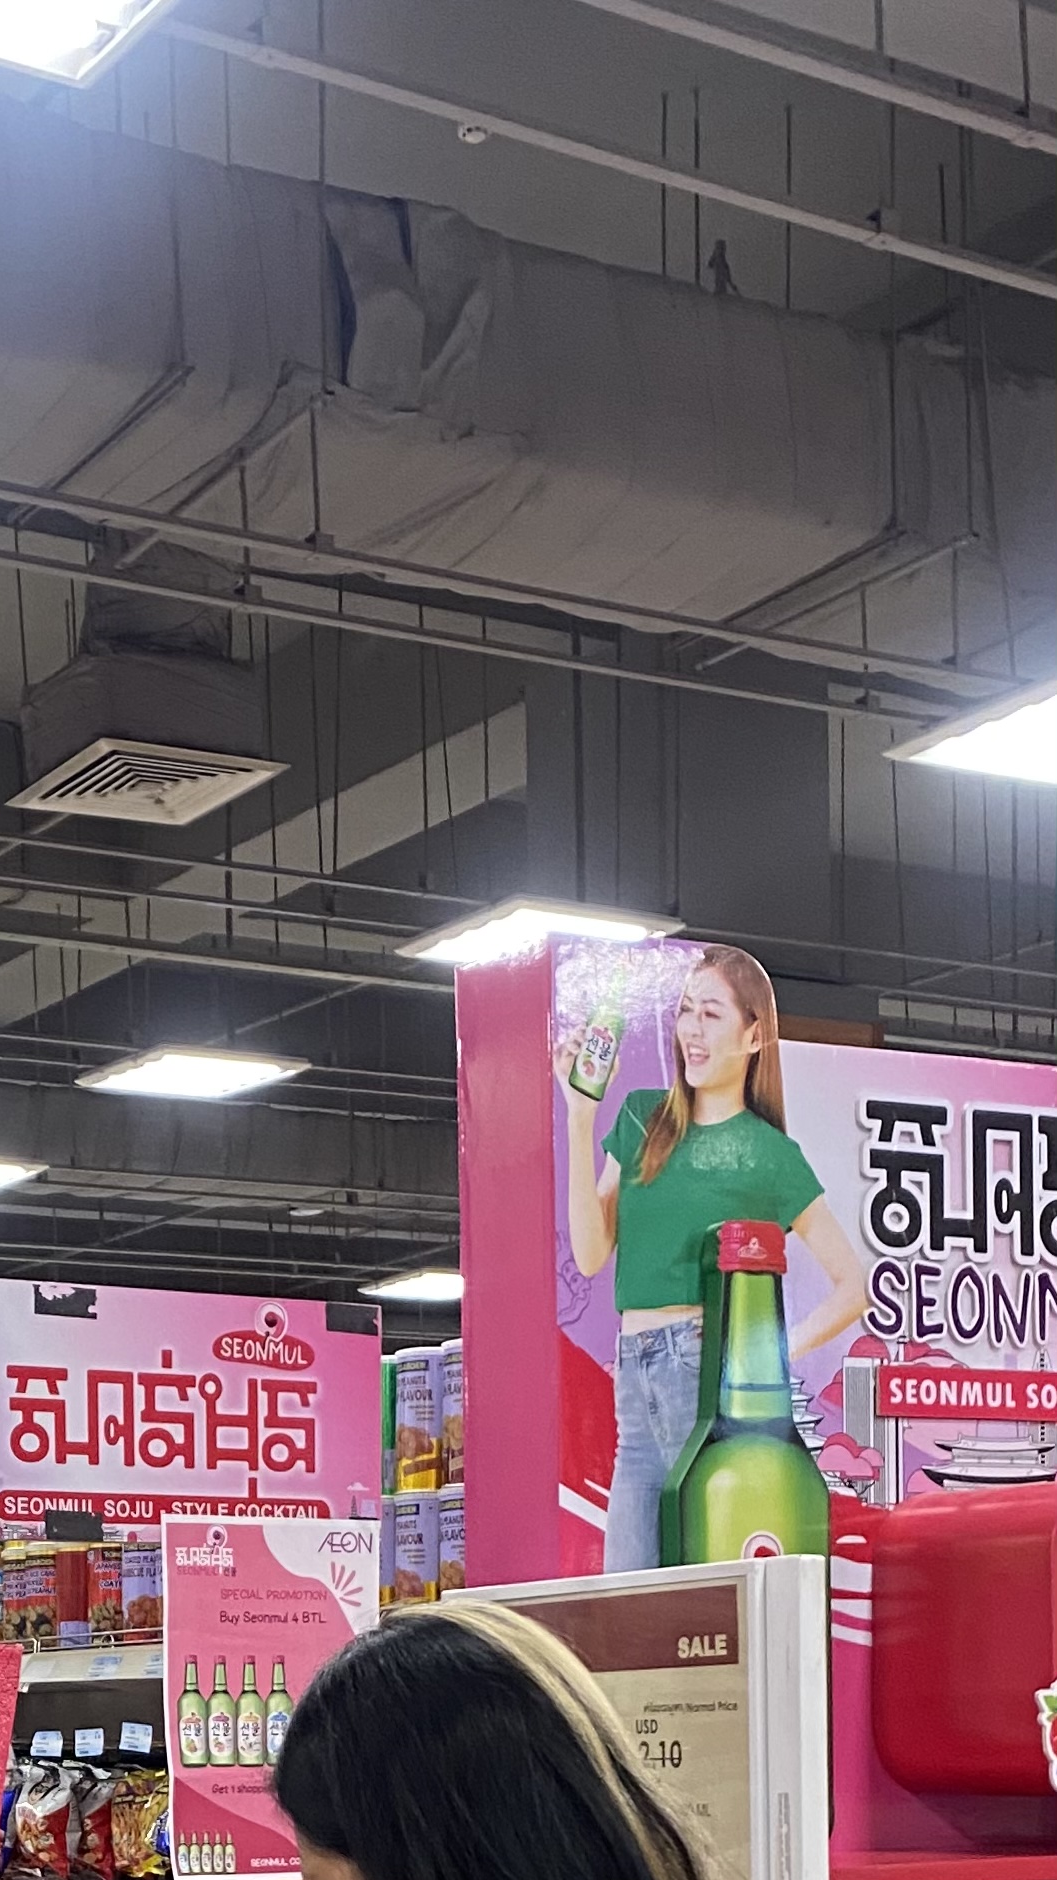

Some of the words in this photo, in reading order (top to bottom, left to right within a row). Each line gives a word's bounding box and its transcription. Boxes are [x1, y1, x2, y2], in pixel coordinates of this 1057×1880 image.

[219, 1337, 308, 1365] SEONMUL
[889, 1378, 1016, 1408] SEONMUL
[4, 1495, 94, 1517] SEONMUL
[104, 1499, 153, 1518] SOJU
[171, 1501, 228, 1517] STYLE
[234, 1503, 318, 1519] COCKTAIL
[220, 1588, 264, 1600] SPECIAL
[266, 1588, 328, 1601] PROMOTION
[219, 1610, 241, 1625] Buy
[243, 1610, 289, 1624] Seonmul
[292, 1612, 299, 1623] 4
[302, 1611, 327, 1623] BTL
[677, 1634, 727, 1659] SALE
[635, 1719, 658, 1734] USD
[211, 1783, 229, 1794] Get
